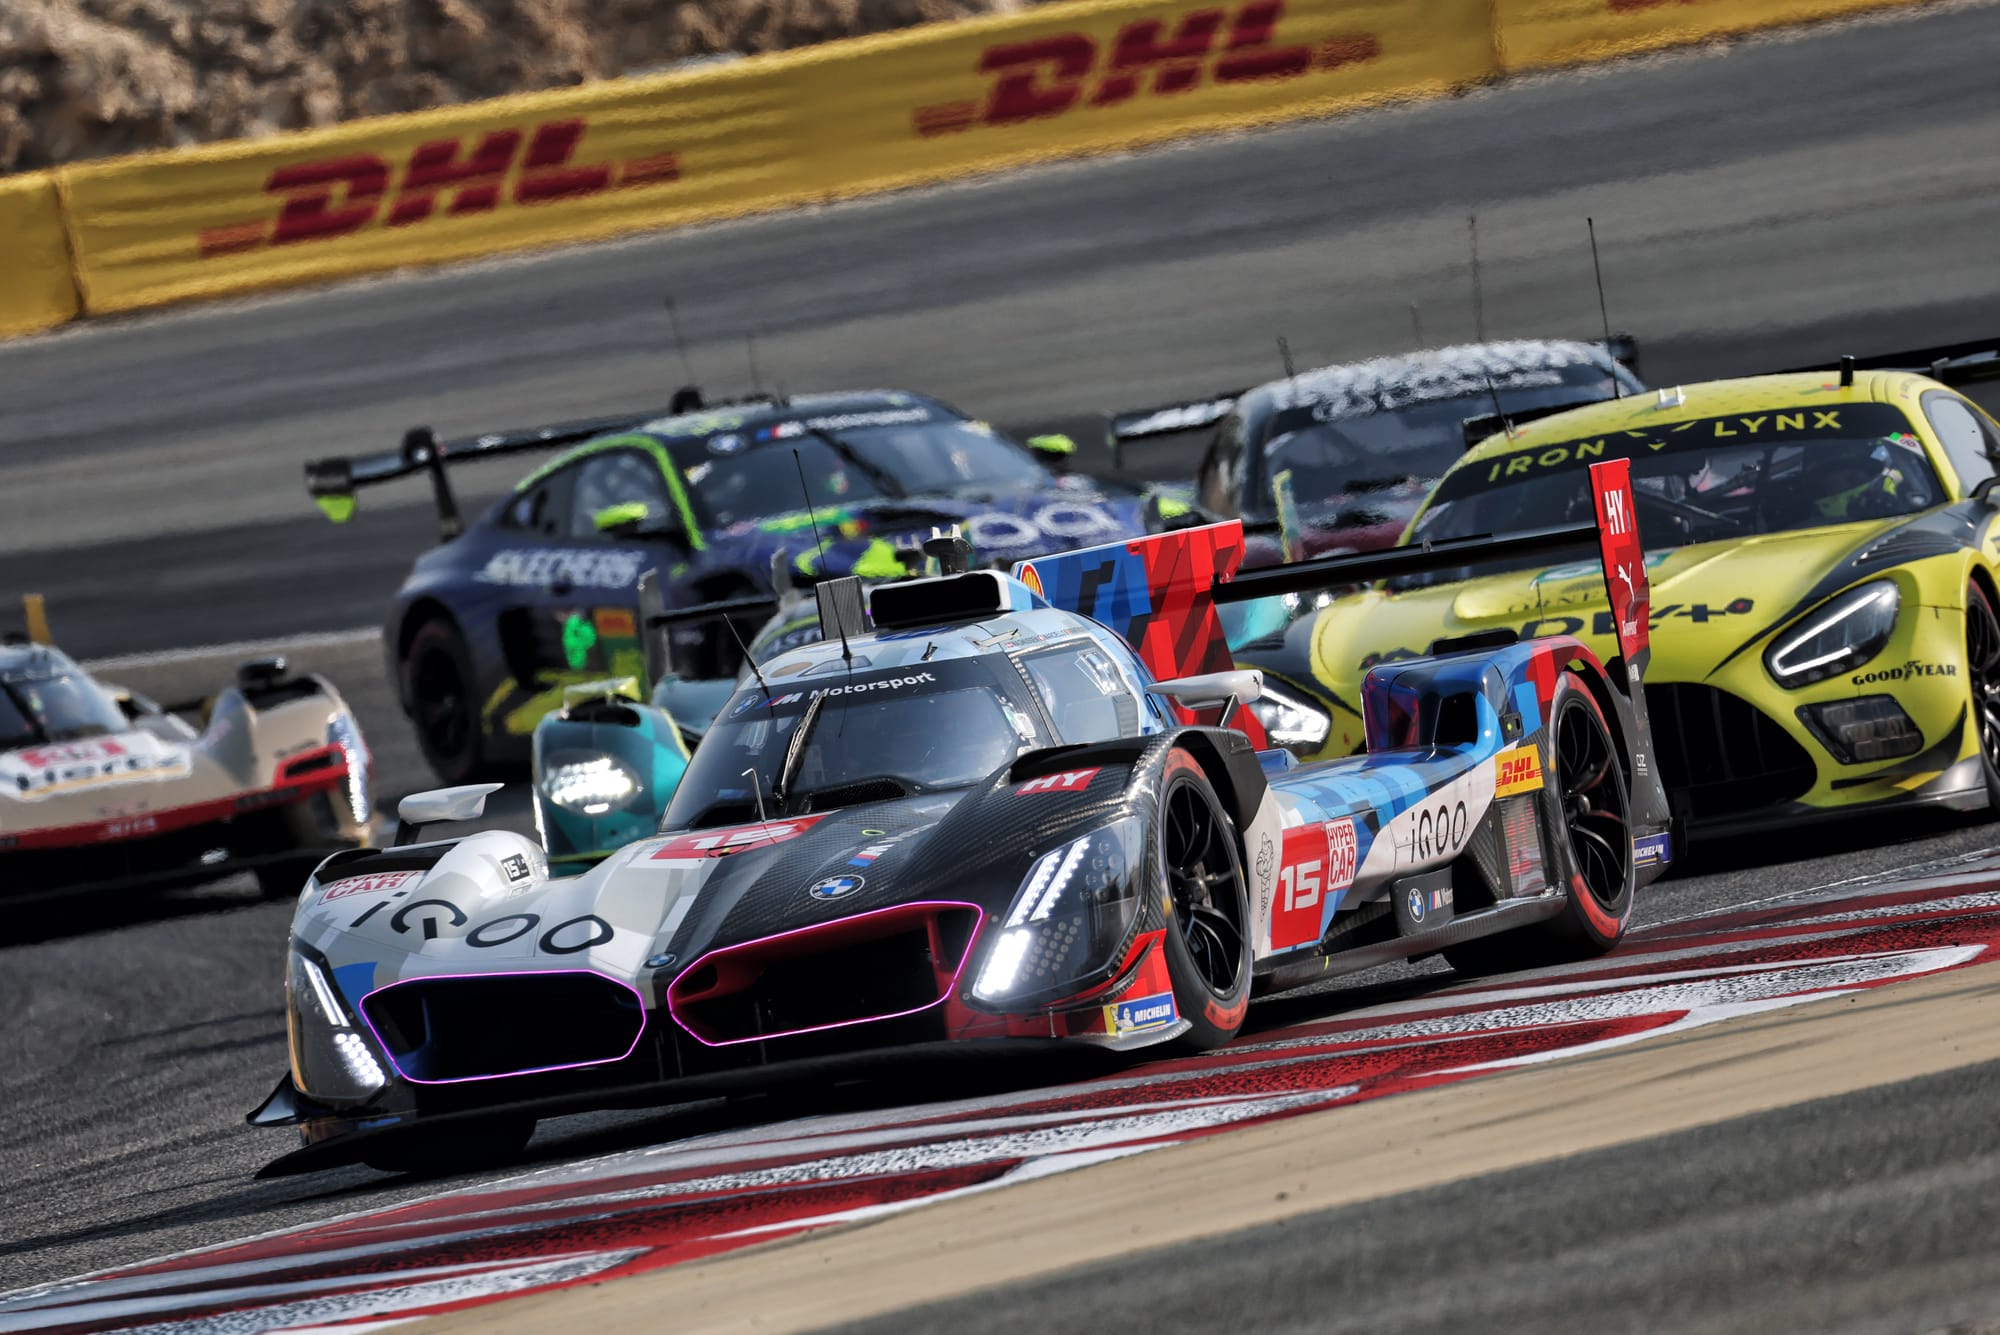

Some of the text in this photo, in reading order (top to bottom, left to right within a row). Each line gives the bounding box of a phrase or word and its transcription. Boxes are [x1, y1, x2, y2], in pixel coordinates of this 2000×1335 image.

[978, 0, 1312, 125] DHL
[264, 118, 610, 246] DHL
[1488, 411, 1842, 482] IRON LYNX
[1604, 489, 1625, 535] HY
[809, 672, 936, 700] Motorsport
[1852, 660, 1957, 685] GOODYEAR
[1022, 770, 1095, 791] HY
[1500, 756, 1538, 786] DHL
[689, 823, 799, 850] 15
[1327, 823, 1356, 849] HYPER
[1410, 801, 1467, 863] iQOO
[1329, 848, 1354, 886] CAR
[326, 878, 402, 900] CAR
[1279, 859, 1322, 913] 15
[1134, 1003, 1172, 1023] MICHELIN
